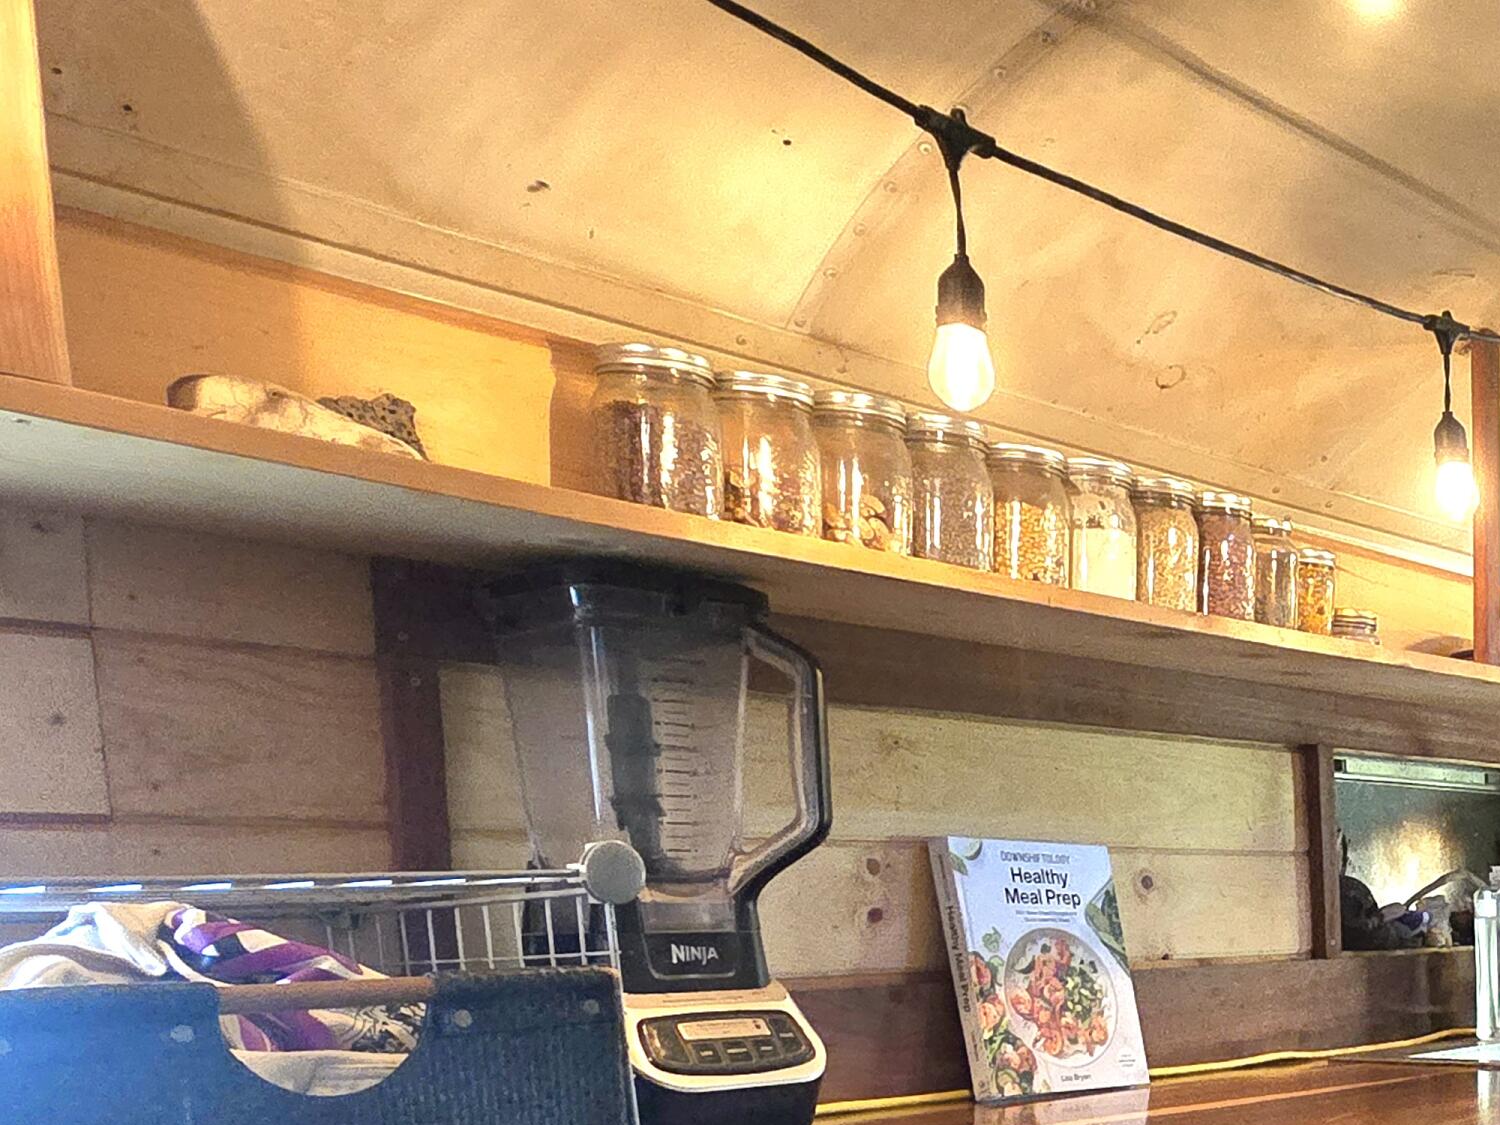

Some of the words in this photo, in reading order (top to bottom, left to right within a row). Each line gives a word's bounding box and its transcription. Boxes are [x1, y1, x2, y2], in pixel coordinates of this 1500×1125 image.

[1010, 866, 1068, 889] Healthy
[1004, 887, 1043, 905] Meal
[1045, 888, 1081, 909] Prep
[670, 943, 719, 966] NINJA
